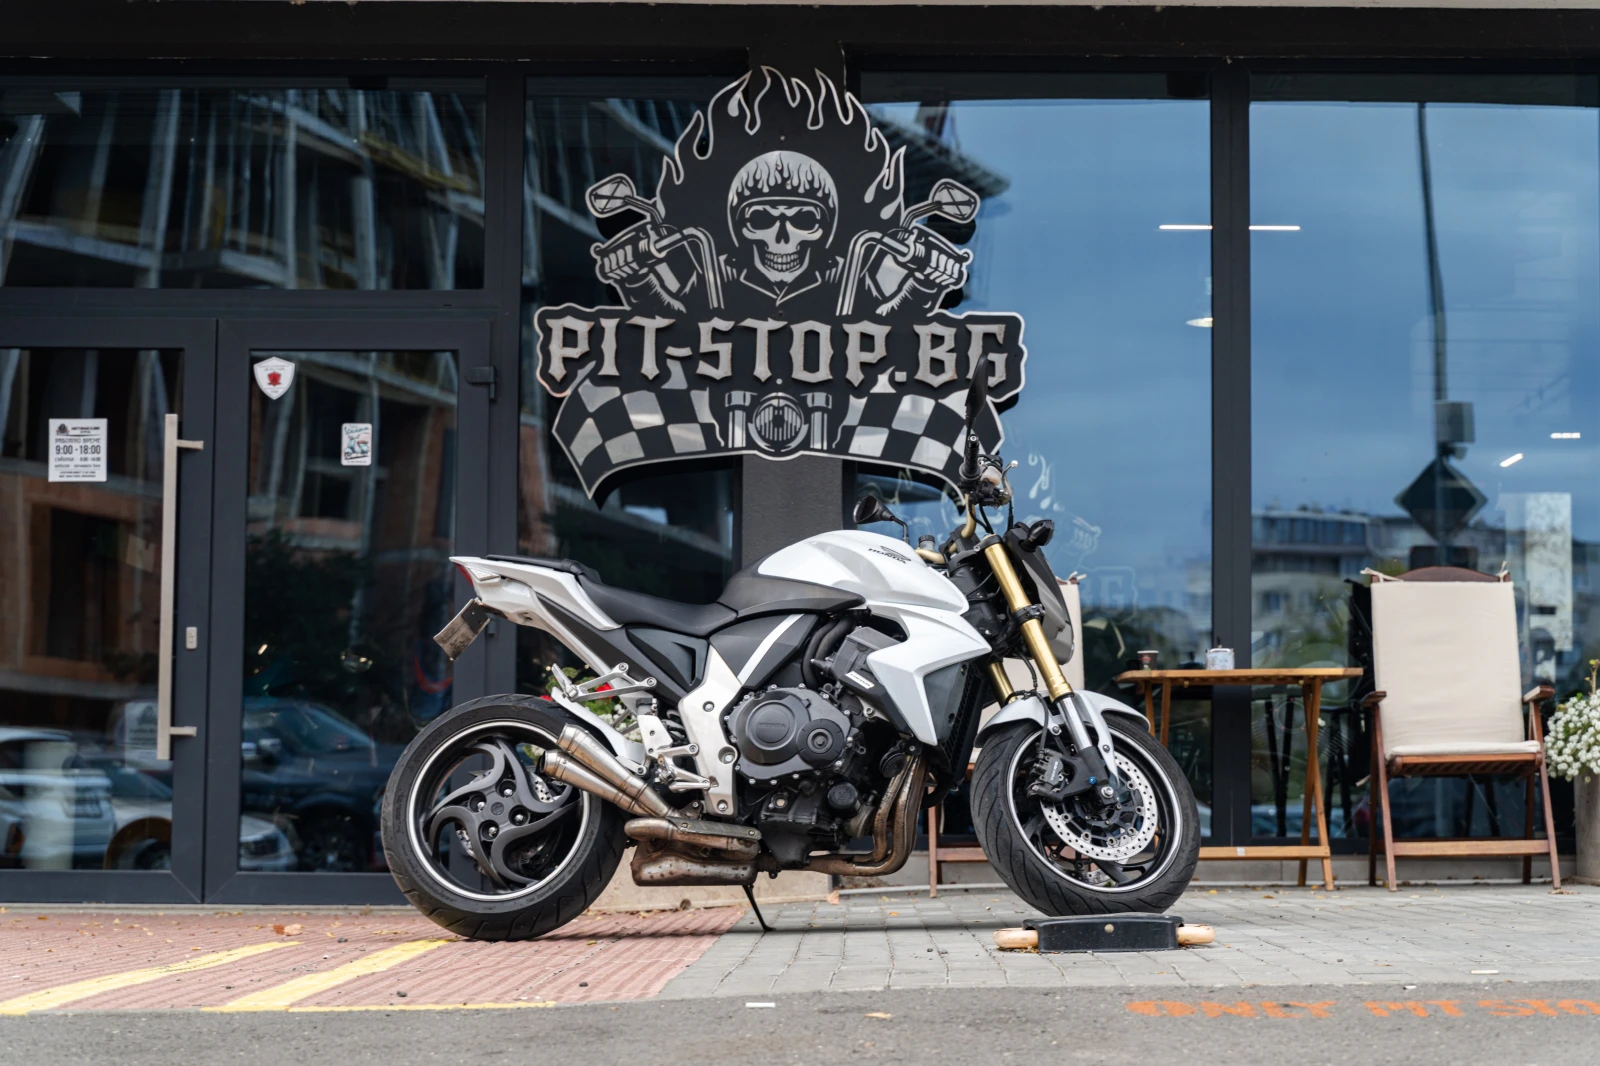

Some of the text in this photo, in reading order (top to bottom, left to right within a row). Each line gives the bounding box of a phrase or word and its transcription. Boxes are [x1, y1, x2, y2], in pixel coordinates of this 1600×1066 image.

[547, 316, 1008, 389] PIT-STOP.BG
[55, 445, 73, 455] 9:00
[80, 445, 101, 455] 18:00
[1126, 1001, 1337, 1018] ONLY
[1363, 1000, 1464, 1017] PIT
